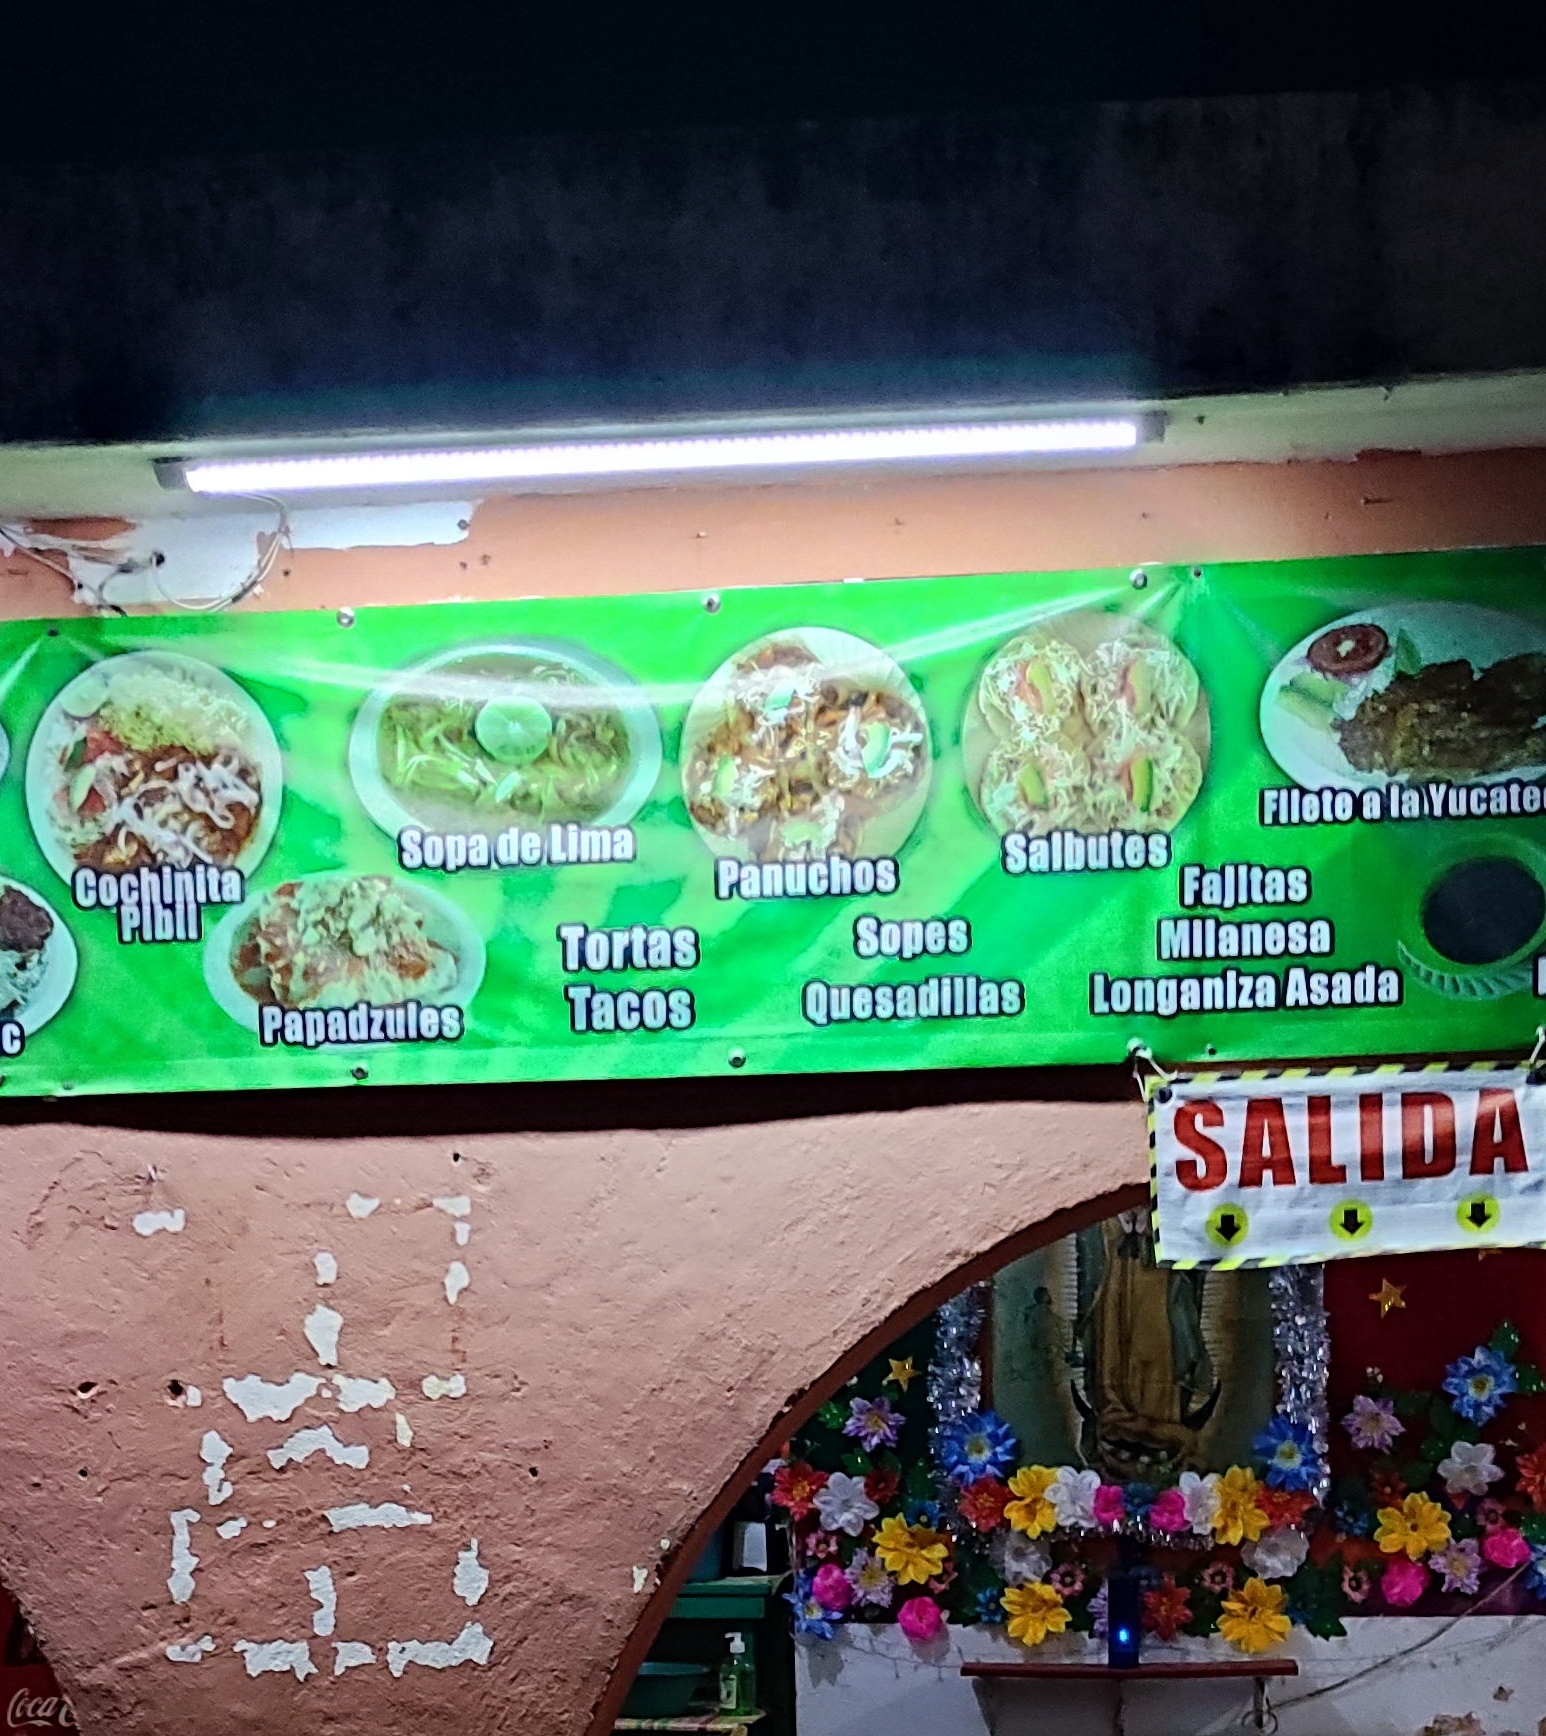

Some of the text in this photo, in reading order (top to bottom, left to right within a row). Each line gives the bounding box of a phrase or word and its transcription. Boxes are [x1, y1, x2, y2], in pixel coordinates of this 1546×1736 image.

[1261, 788, 1352, 824] Filete
[1357, 795, 1378, 818] a
[1385, 788, 1425, 818] la
[400, 826, 634, 870] Sopa de Lima
[1005, 832, 1171, 874] Salbutes
[74, 865, 243, 907] Cochinita
[717, 857, 899, 899] Panuchos
[1180, 865, 1308, 909] Fajitas
[120, 896, 200, 944] Pibil
[855, 917, 970, 959] Sopes
[1158, 919, 1333, 963] Milanesa
[560, 924, 698, 972] Tortas
[569, 986, 695, 1032] Tacos
[801, 977, 1025, 1024] Quesadillas
[1092, 965, 1401, 1019] Longaniza Asada
[260, 1004, 462, 1045] Papadzules
[1173, 1088, 1529, 1192] SALIDA
